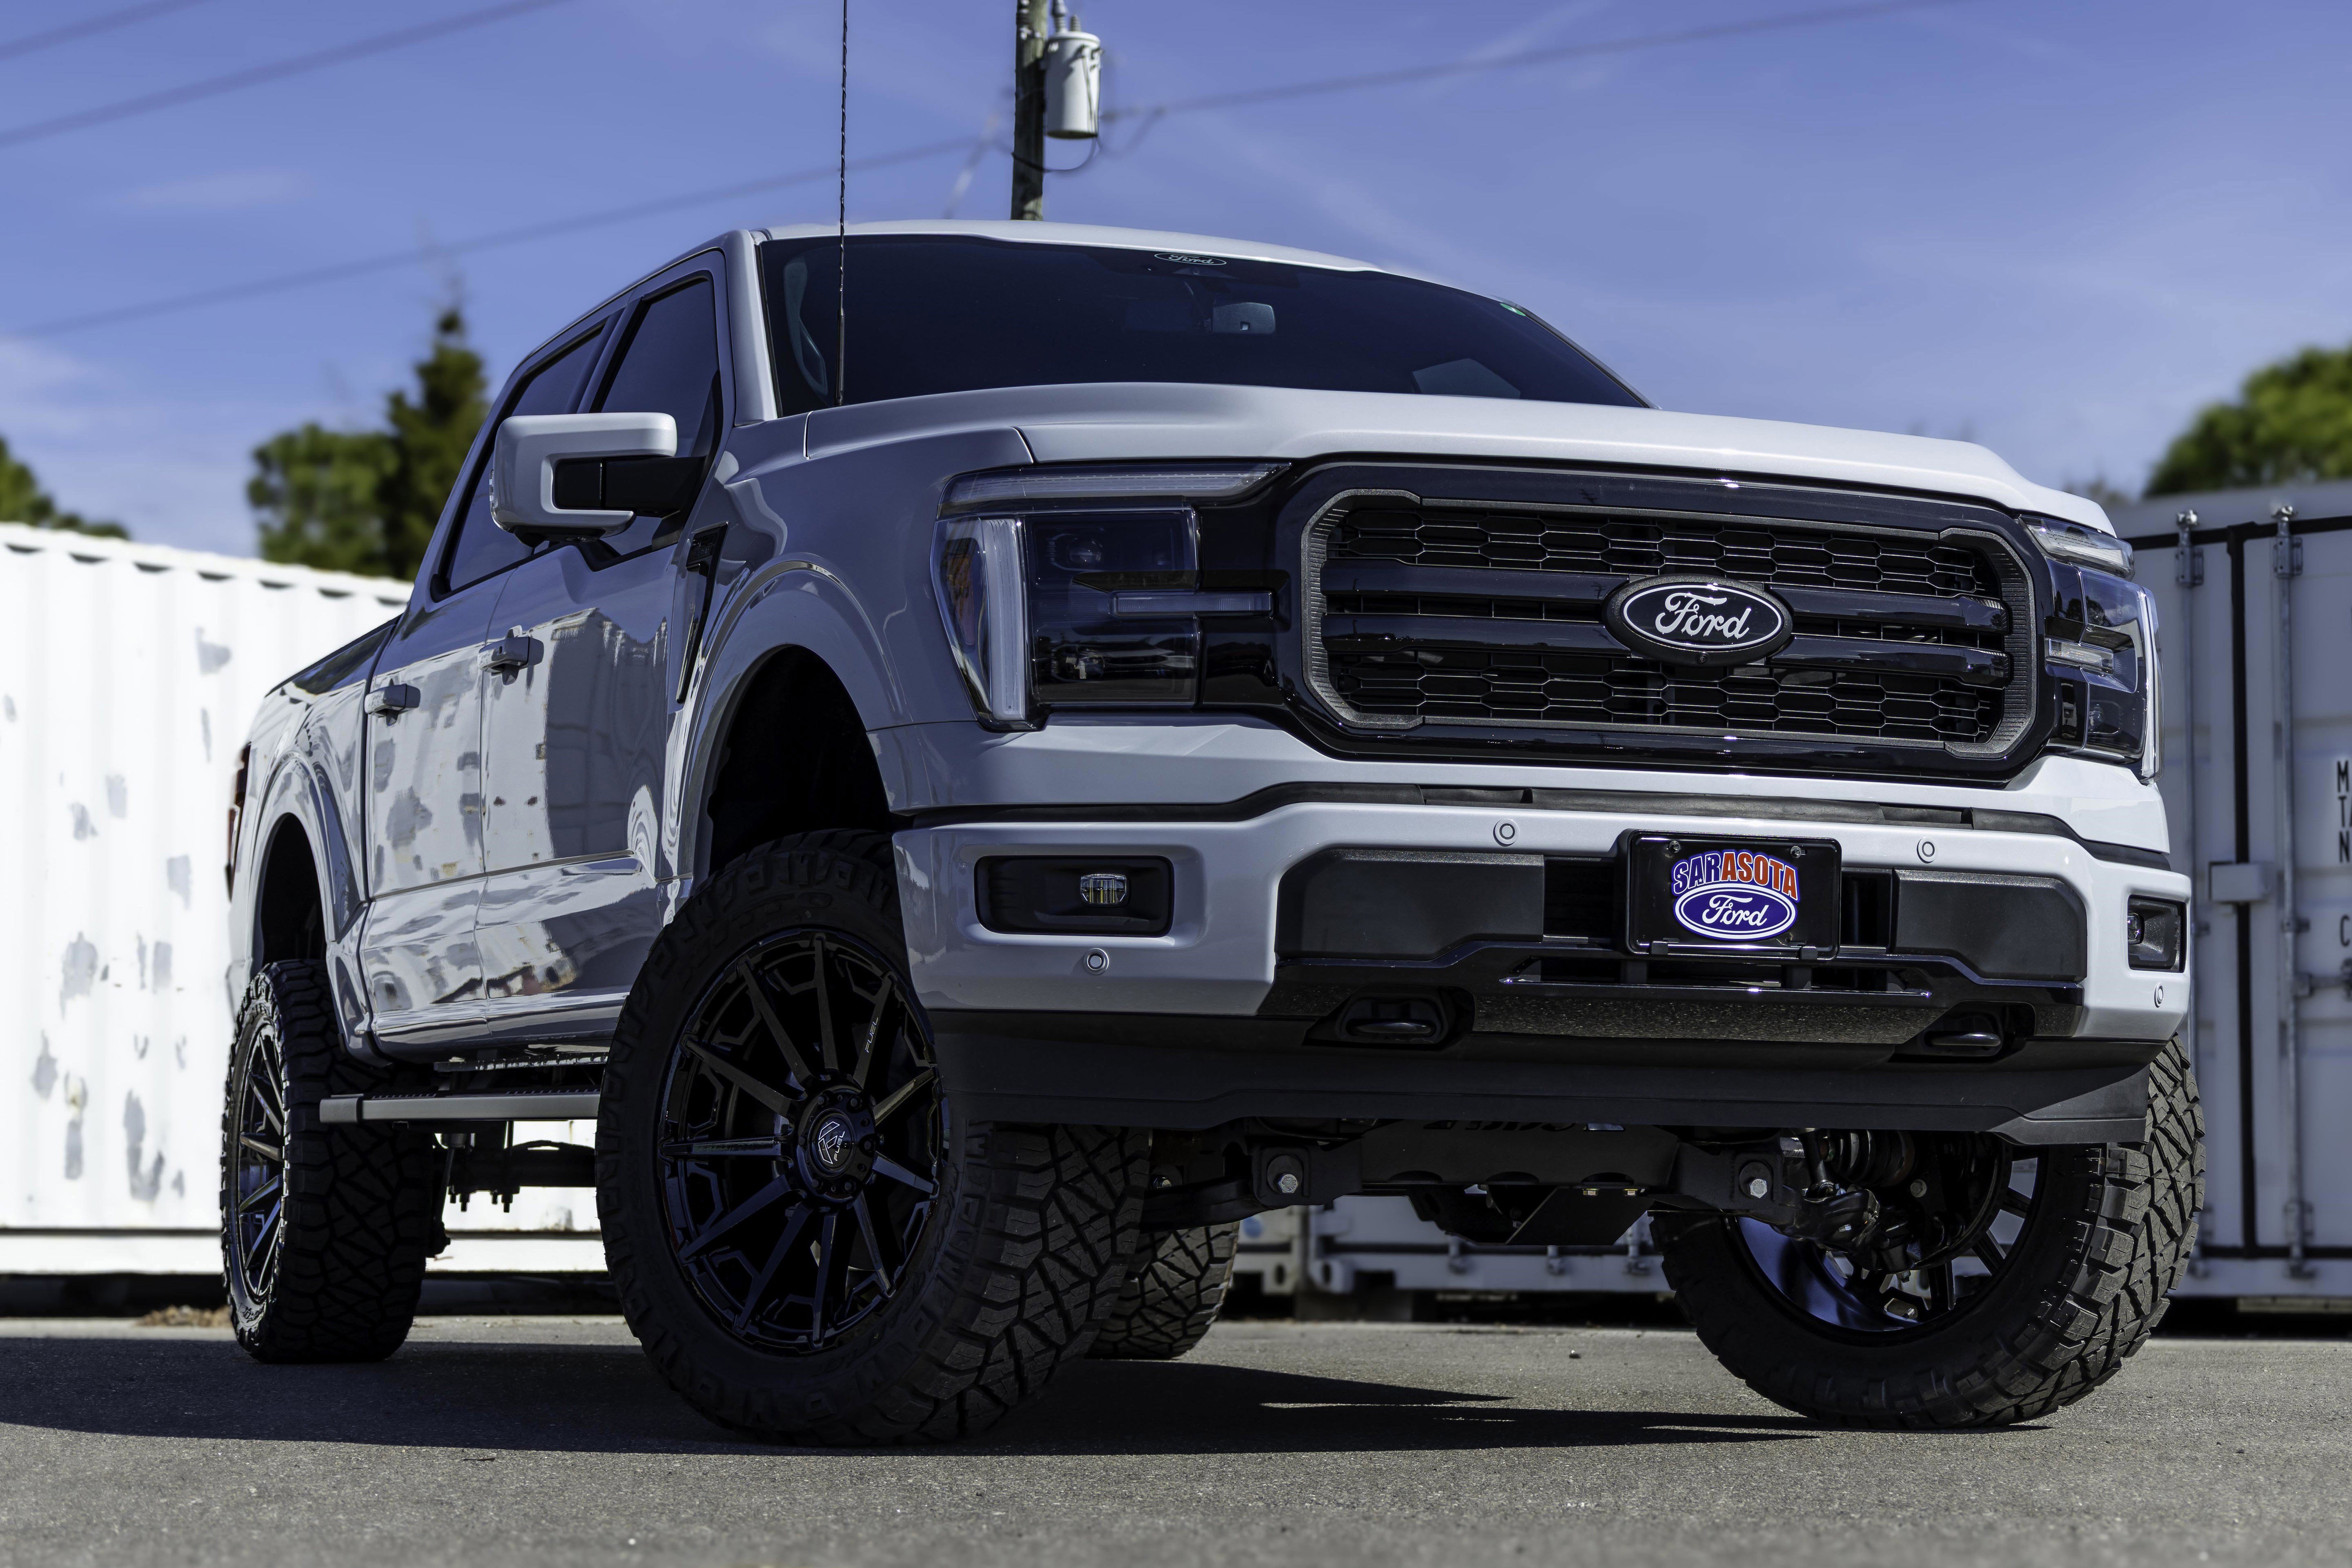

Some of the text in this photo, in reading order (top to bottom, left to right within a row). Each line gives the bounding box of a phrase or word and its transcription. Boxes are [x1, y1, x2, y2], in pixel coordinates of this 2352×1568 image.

[1168, 254, 1214, 264] Ford
[1655, 592, 1751, 639] Ford
[1673, 851, 1798, 901] SARASOTA
[1702, 894, 1769, 926] Ford
[865, 1017, 879, 1053] FUEL
[834, 1131, 845, 1161] FUEL
